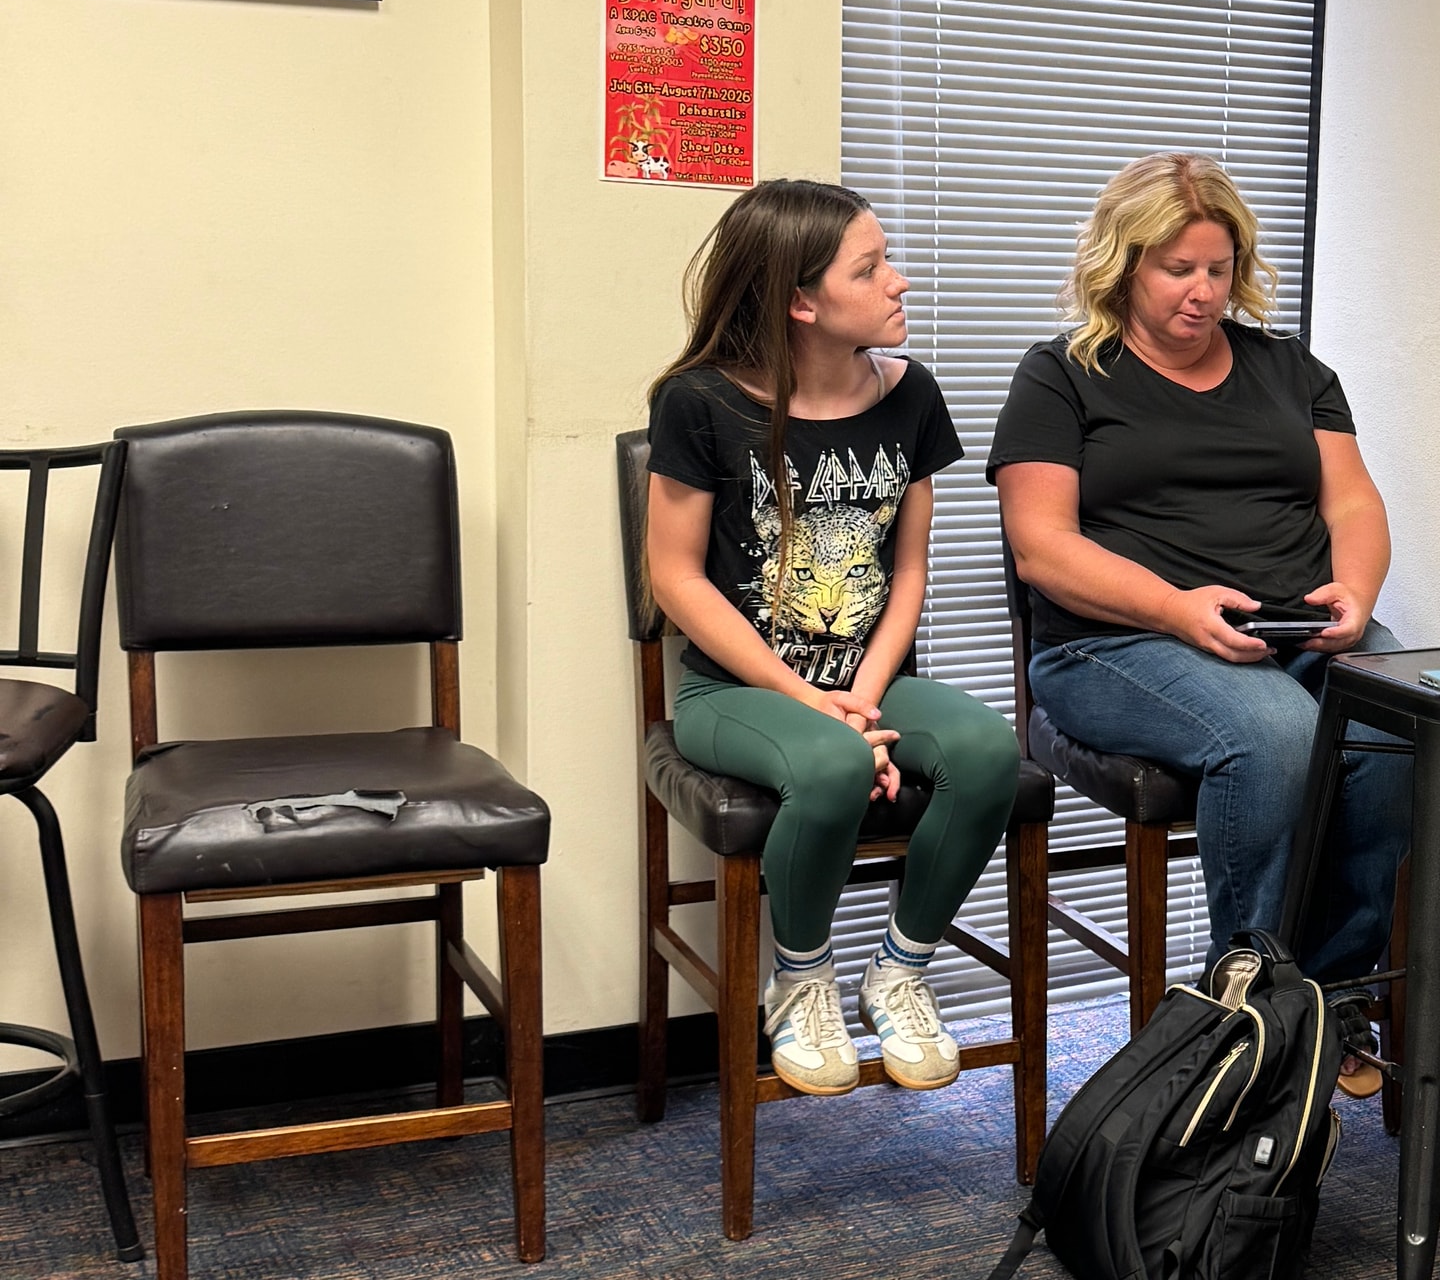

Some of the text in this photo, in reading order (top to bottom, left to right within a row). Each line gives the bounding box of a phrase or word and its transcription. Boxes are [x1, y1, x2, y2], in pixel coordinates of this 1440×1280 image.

[609, 6, 752, 35] A KPAC Theatre Camp
[700, 34, 746, 57] $350
[610, 78, 632, 93] July
[700, 86, 719, 99] 7th
[720, 88, 751, 103] 2026
[679, 102, 746, 120] Rehearsals:
[681, 140, 744, 155] Show Date:
[805, 443, 911, 513] LEPPARD
